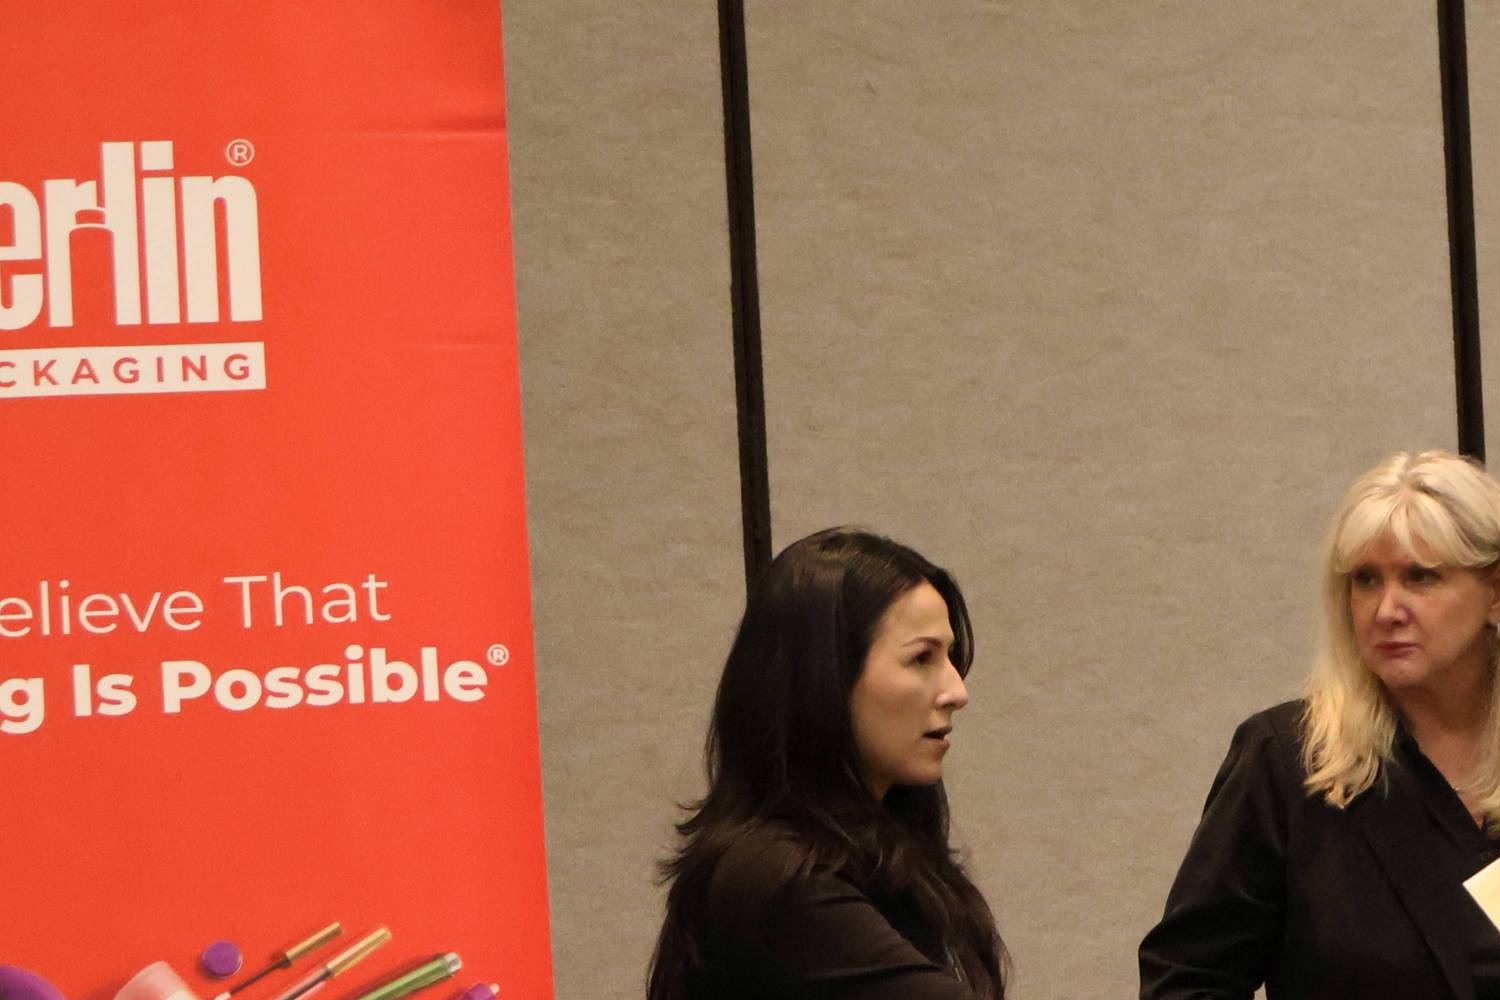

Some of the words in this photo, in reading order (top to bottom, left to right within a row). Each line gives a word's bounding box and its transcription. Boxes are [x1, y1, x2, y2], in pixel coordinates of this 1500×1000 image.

[0, 578, 204, 635] elieve
[224, 571, 392, 629] That
[73, 663, 137, 718] Is
